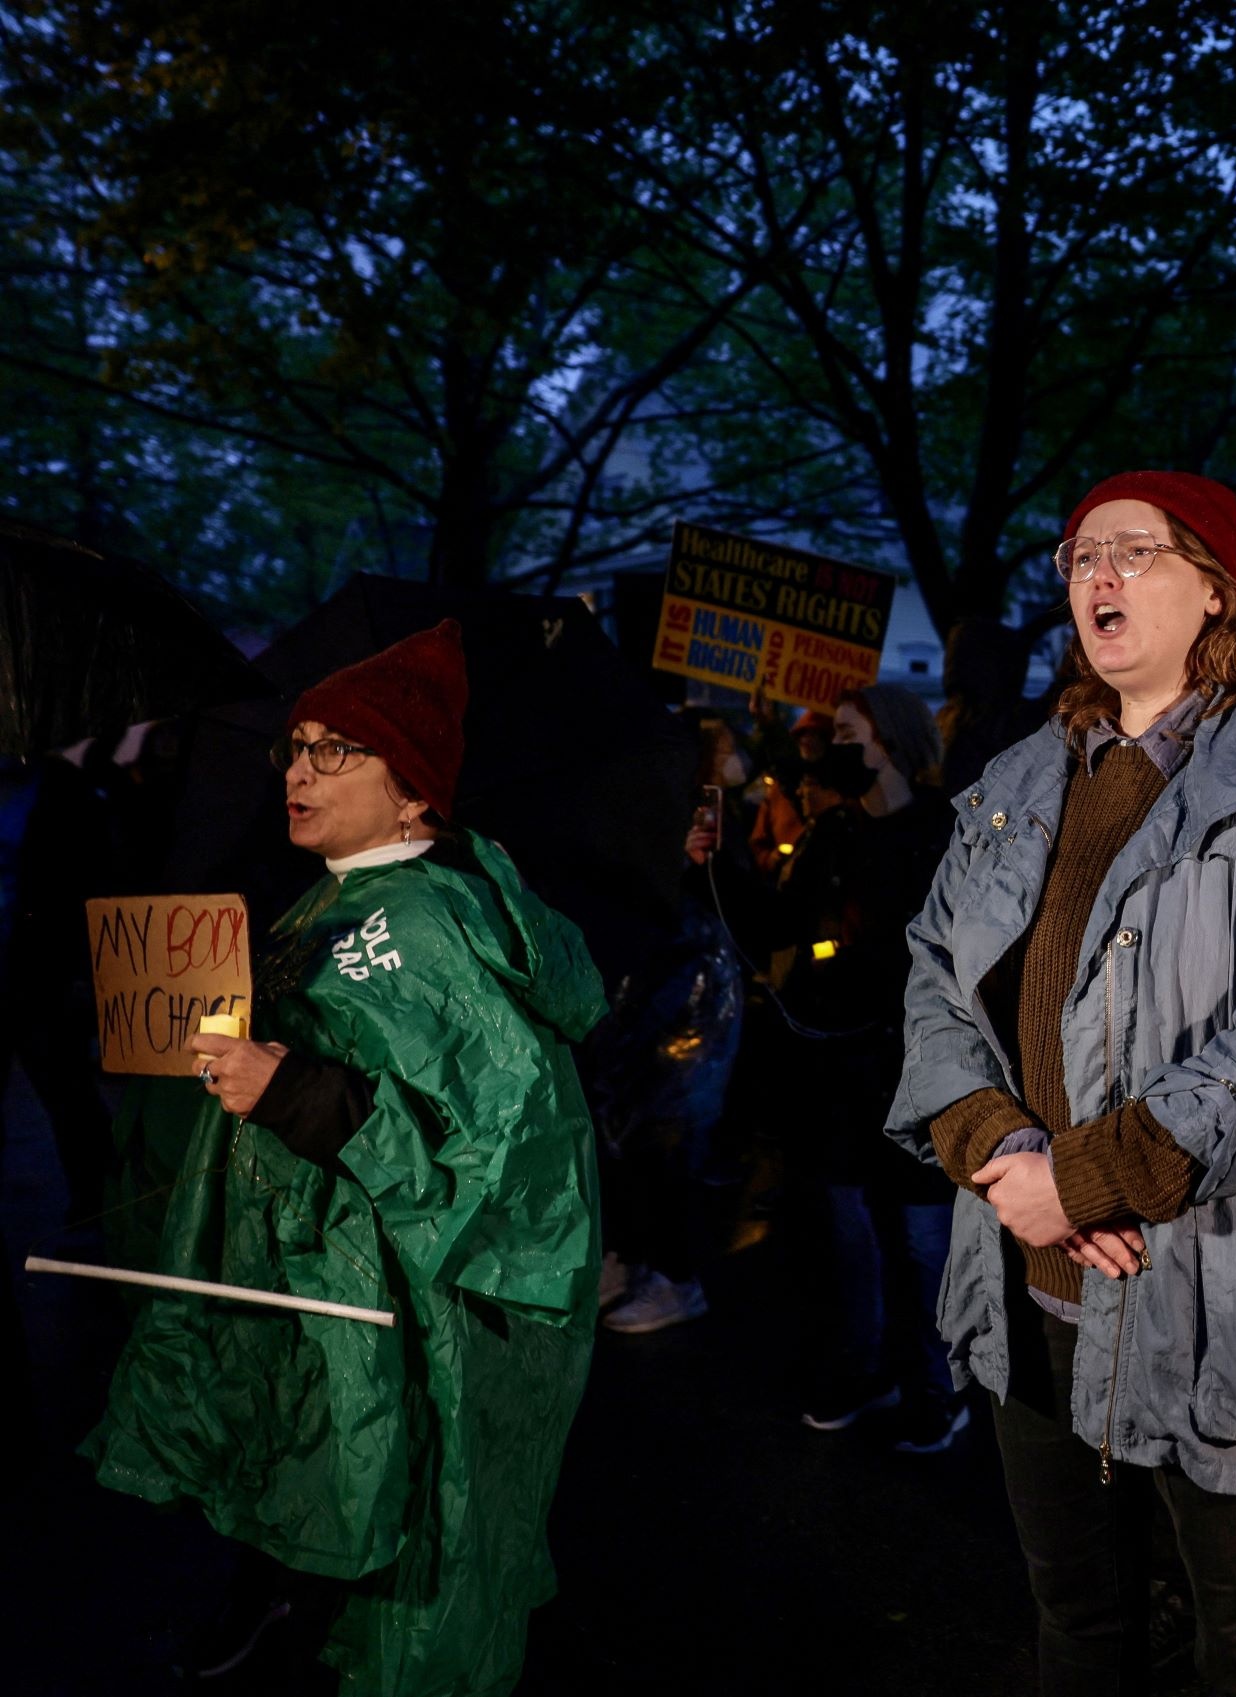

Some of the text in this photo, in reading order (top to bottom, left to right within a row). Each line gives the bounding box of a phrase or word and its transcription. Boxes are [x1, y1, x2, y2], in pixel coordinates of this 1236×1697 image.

[680, 525, 808, 583] Healthcare
[659, 604, 691, 663] IT IS
[692, 607, 766, 651] HUMAN
[776, 585, 882, 641] RIGHTS
[687, 639, 759, 682] RIGHTS
[764, 630, 785, 689] AND
[783, 658, 869, 706] CHOI
[793, 632, 873, 675] PERSONAL
[96, 905, 244, 978] MY BODY
[103, 991, 136, 1061] MY
